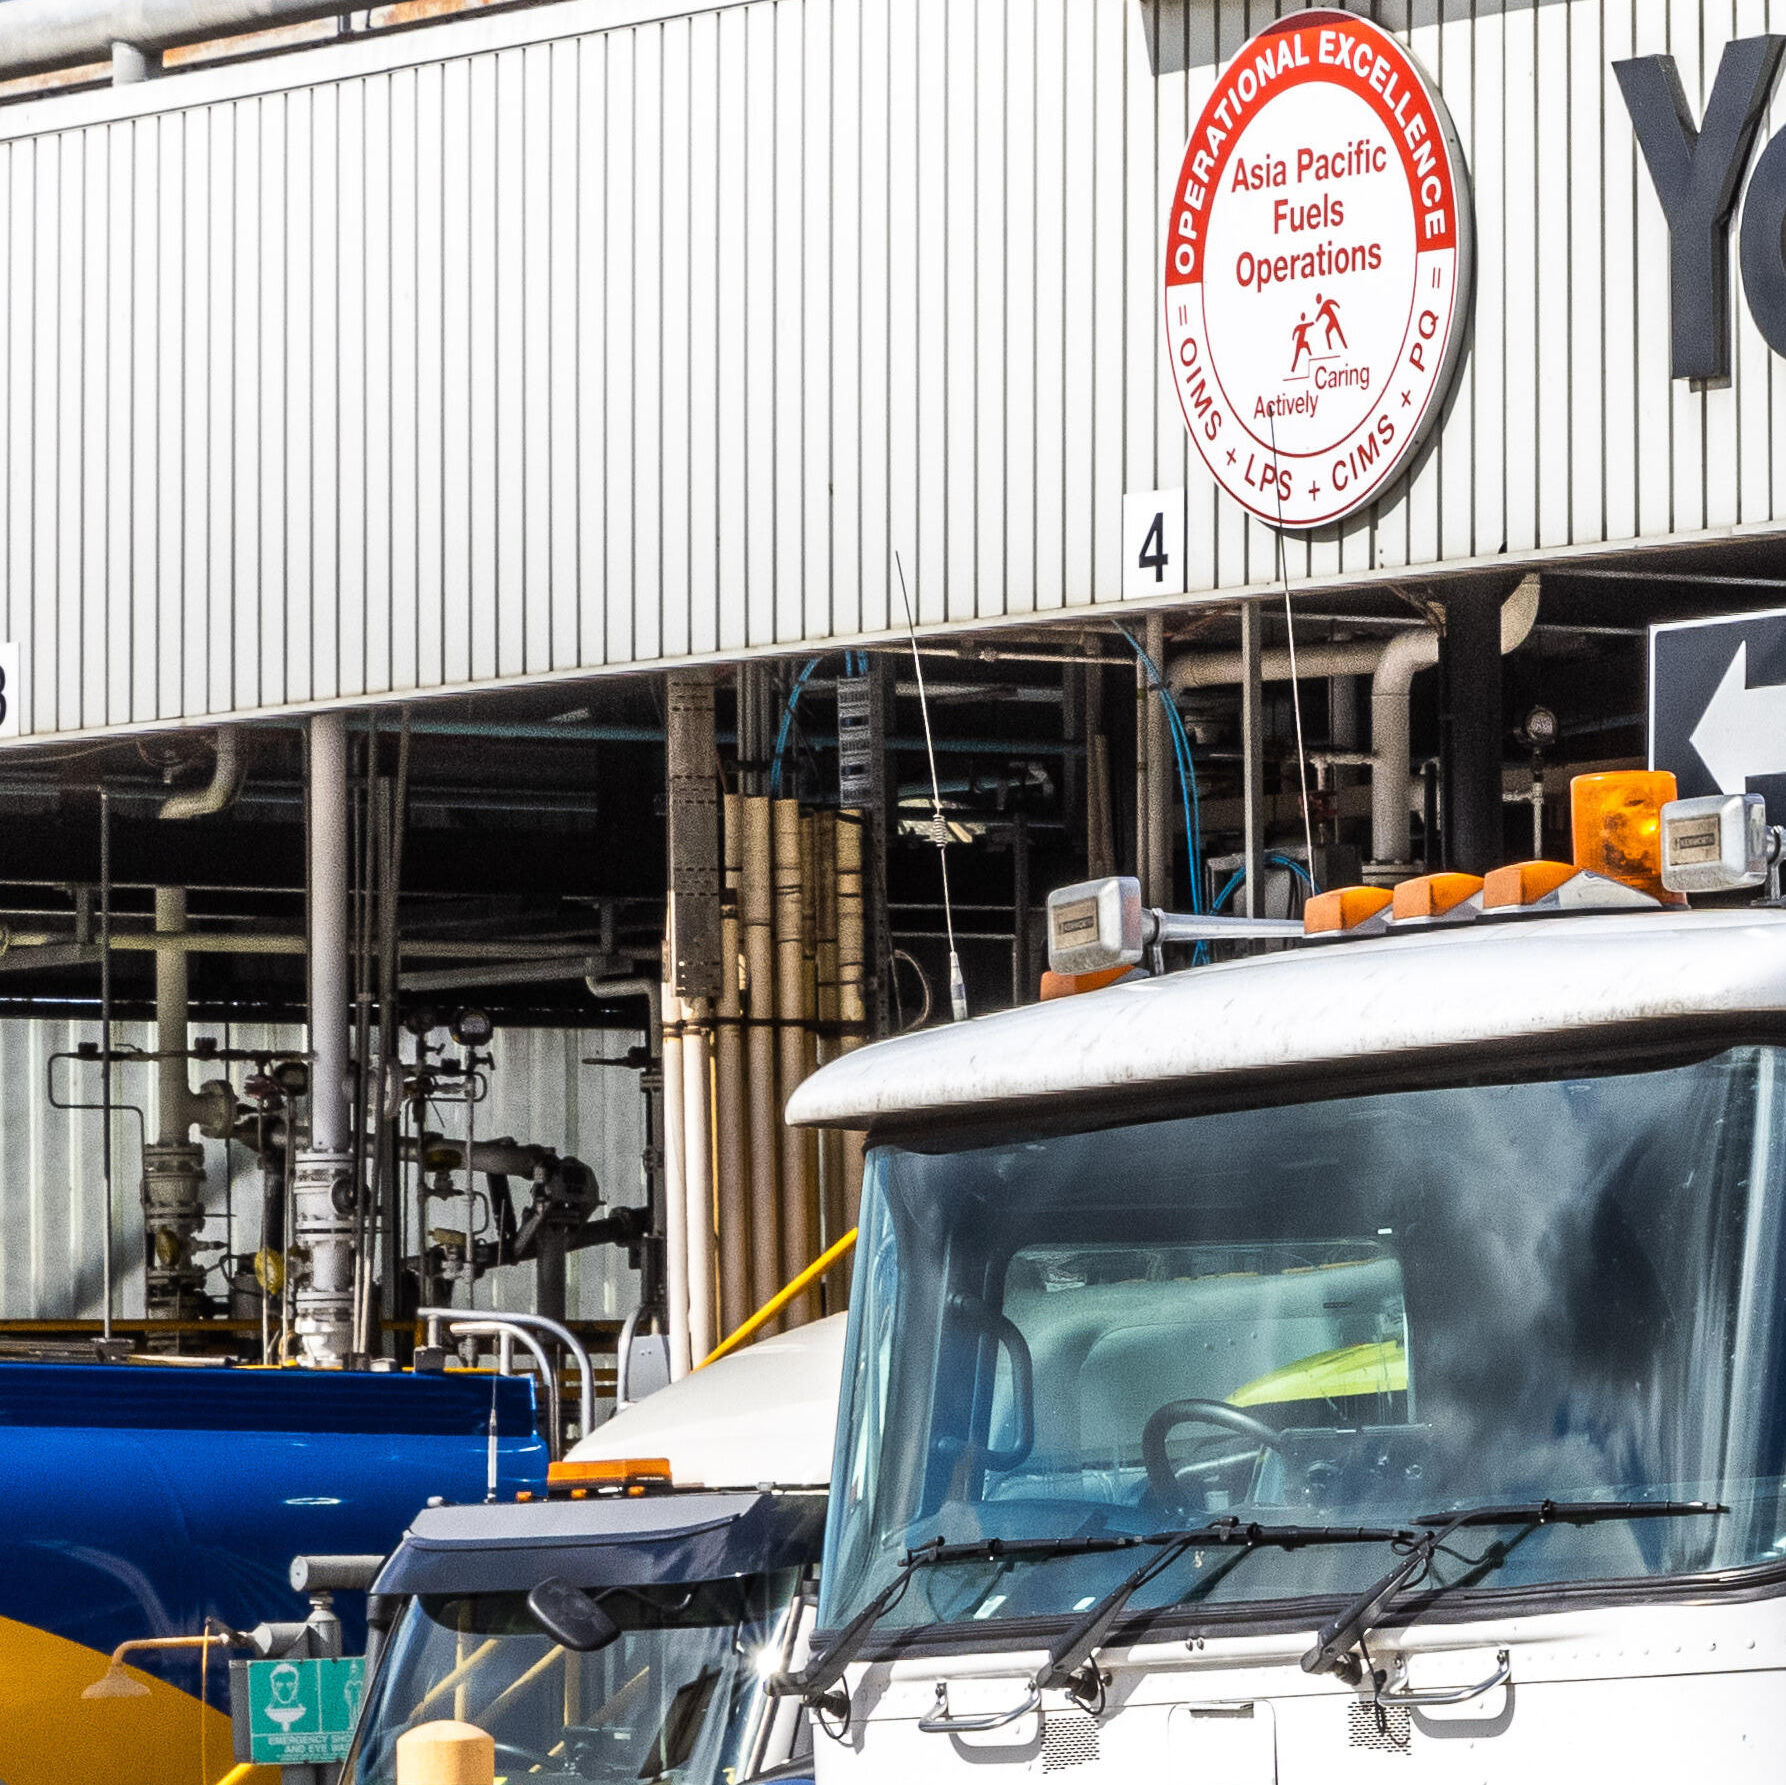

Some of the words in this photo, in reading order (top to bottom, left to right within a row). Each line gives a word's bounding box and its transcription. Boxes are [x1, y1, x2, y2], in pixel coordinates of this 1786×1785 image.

[1175, 34, 1310, 275] OPERATIONAL
[1319, 30, 1446, 239] EXCELLENCE
[1232, 154, 1286, 193] Asia
[1297, 139, 1387, 183] Pacific
[1274, 193, 1345, 234] Fuels
[1236, 241, 1382, 293] Operations
[1315, 364, 1370, 391] Caring
[1180, 338, 1222, 441] OIMS
[1244, 454, 1292, 501] LPS
[1332, 414, 1395, 492] CIMS
[1409, 310, 1439, 371] PQ
[1254, 391, 1318, 420] Actively
[1139, 513, 1168, 582] 4
